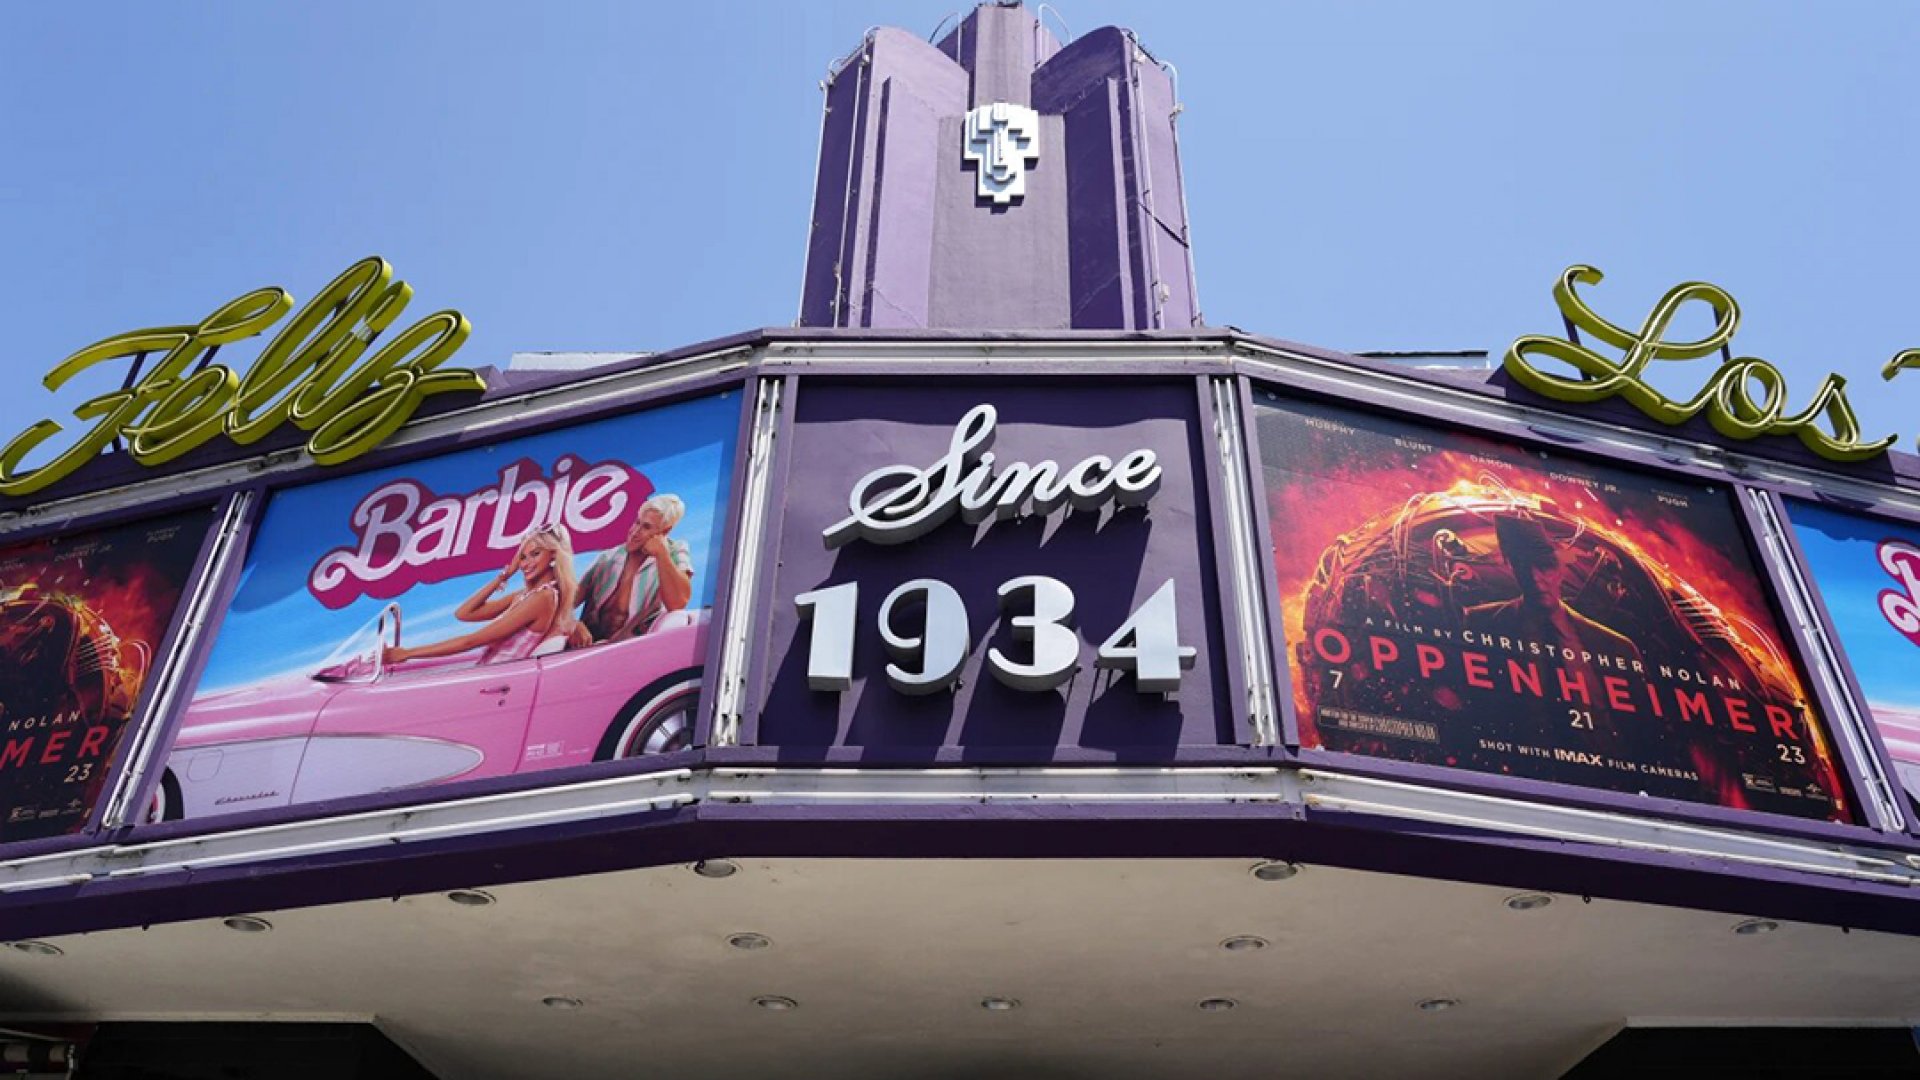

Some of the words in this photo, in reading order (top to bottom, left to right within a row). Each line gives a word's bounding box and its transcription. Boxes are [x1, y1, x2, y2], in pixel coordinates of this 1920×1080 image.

[0, 255, 487, 496] Feliz
[1503, 264, 1898, 461] Los
[823, 403, 1162, 547] Since
[1305, 417, 1355, 436] MURPHY
[1394, 438, 1433, 453] BLUNT
[1470, 454, 1513, 470] DAMON
[1549, 472, 1599, 489] DOWNEY
[1657, 495, 1688, 508] PUGH
[313, 459, 630, 593] Barbie
[795, 575, 1197, 696] 1934
[1314, 628, 1798, 740] OPPENHEIMER
[1364, 617, 1374, 626] A
[1384, 619, 1423, 634] FILM
[1434, 628, 1452, 639] BY
[1463, 630, 1644, 673] CHRISTOPHER
[1660, 665, 1741, 691] NOLAN
[8, 710, 81, 731] NOLAN
[1329, 670, 1343, 689] 7
[1568, 709, 1594, 731] 21
[1776, 744, 1806, 765] 23
[1479, 738, 1512, 752] SHOT
[1518, 745, 1551, 758] WITH
[1554, 748, 1603, 767] IMAX
[1608, 759, 1637, 772] FILM
[1641, 765, 1699, 781] CAMERAS
[63, 763, 94, 784] 23
